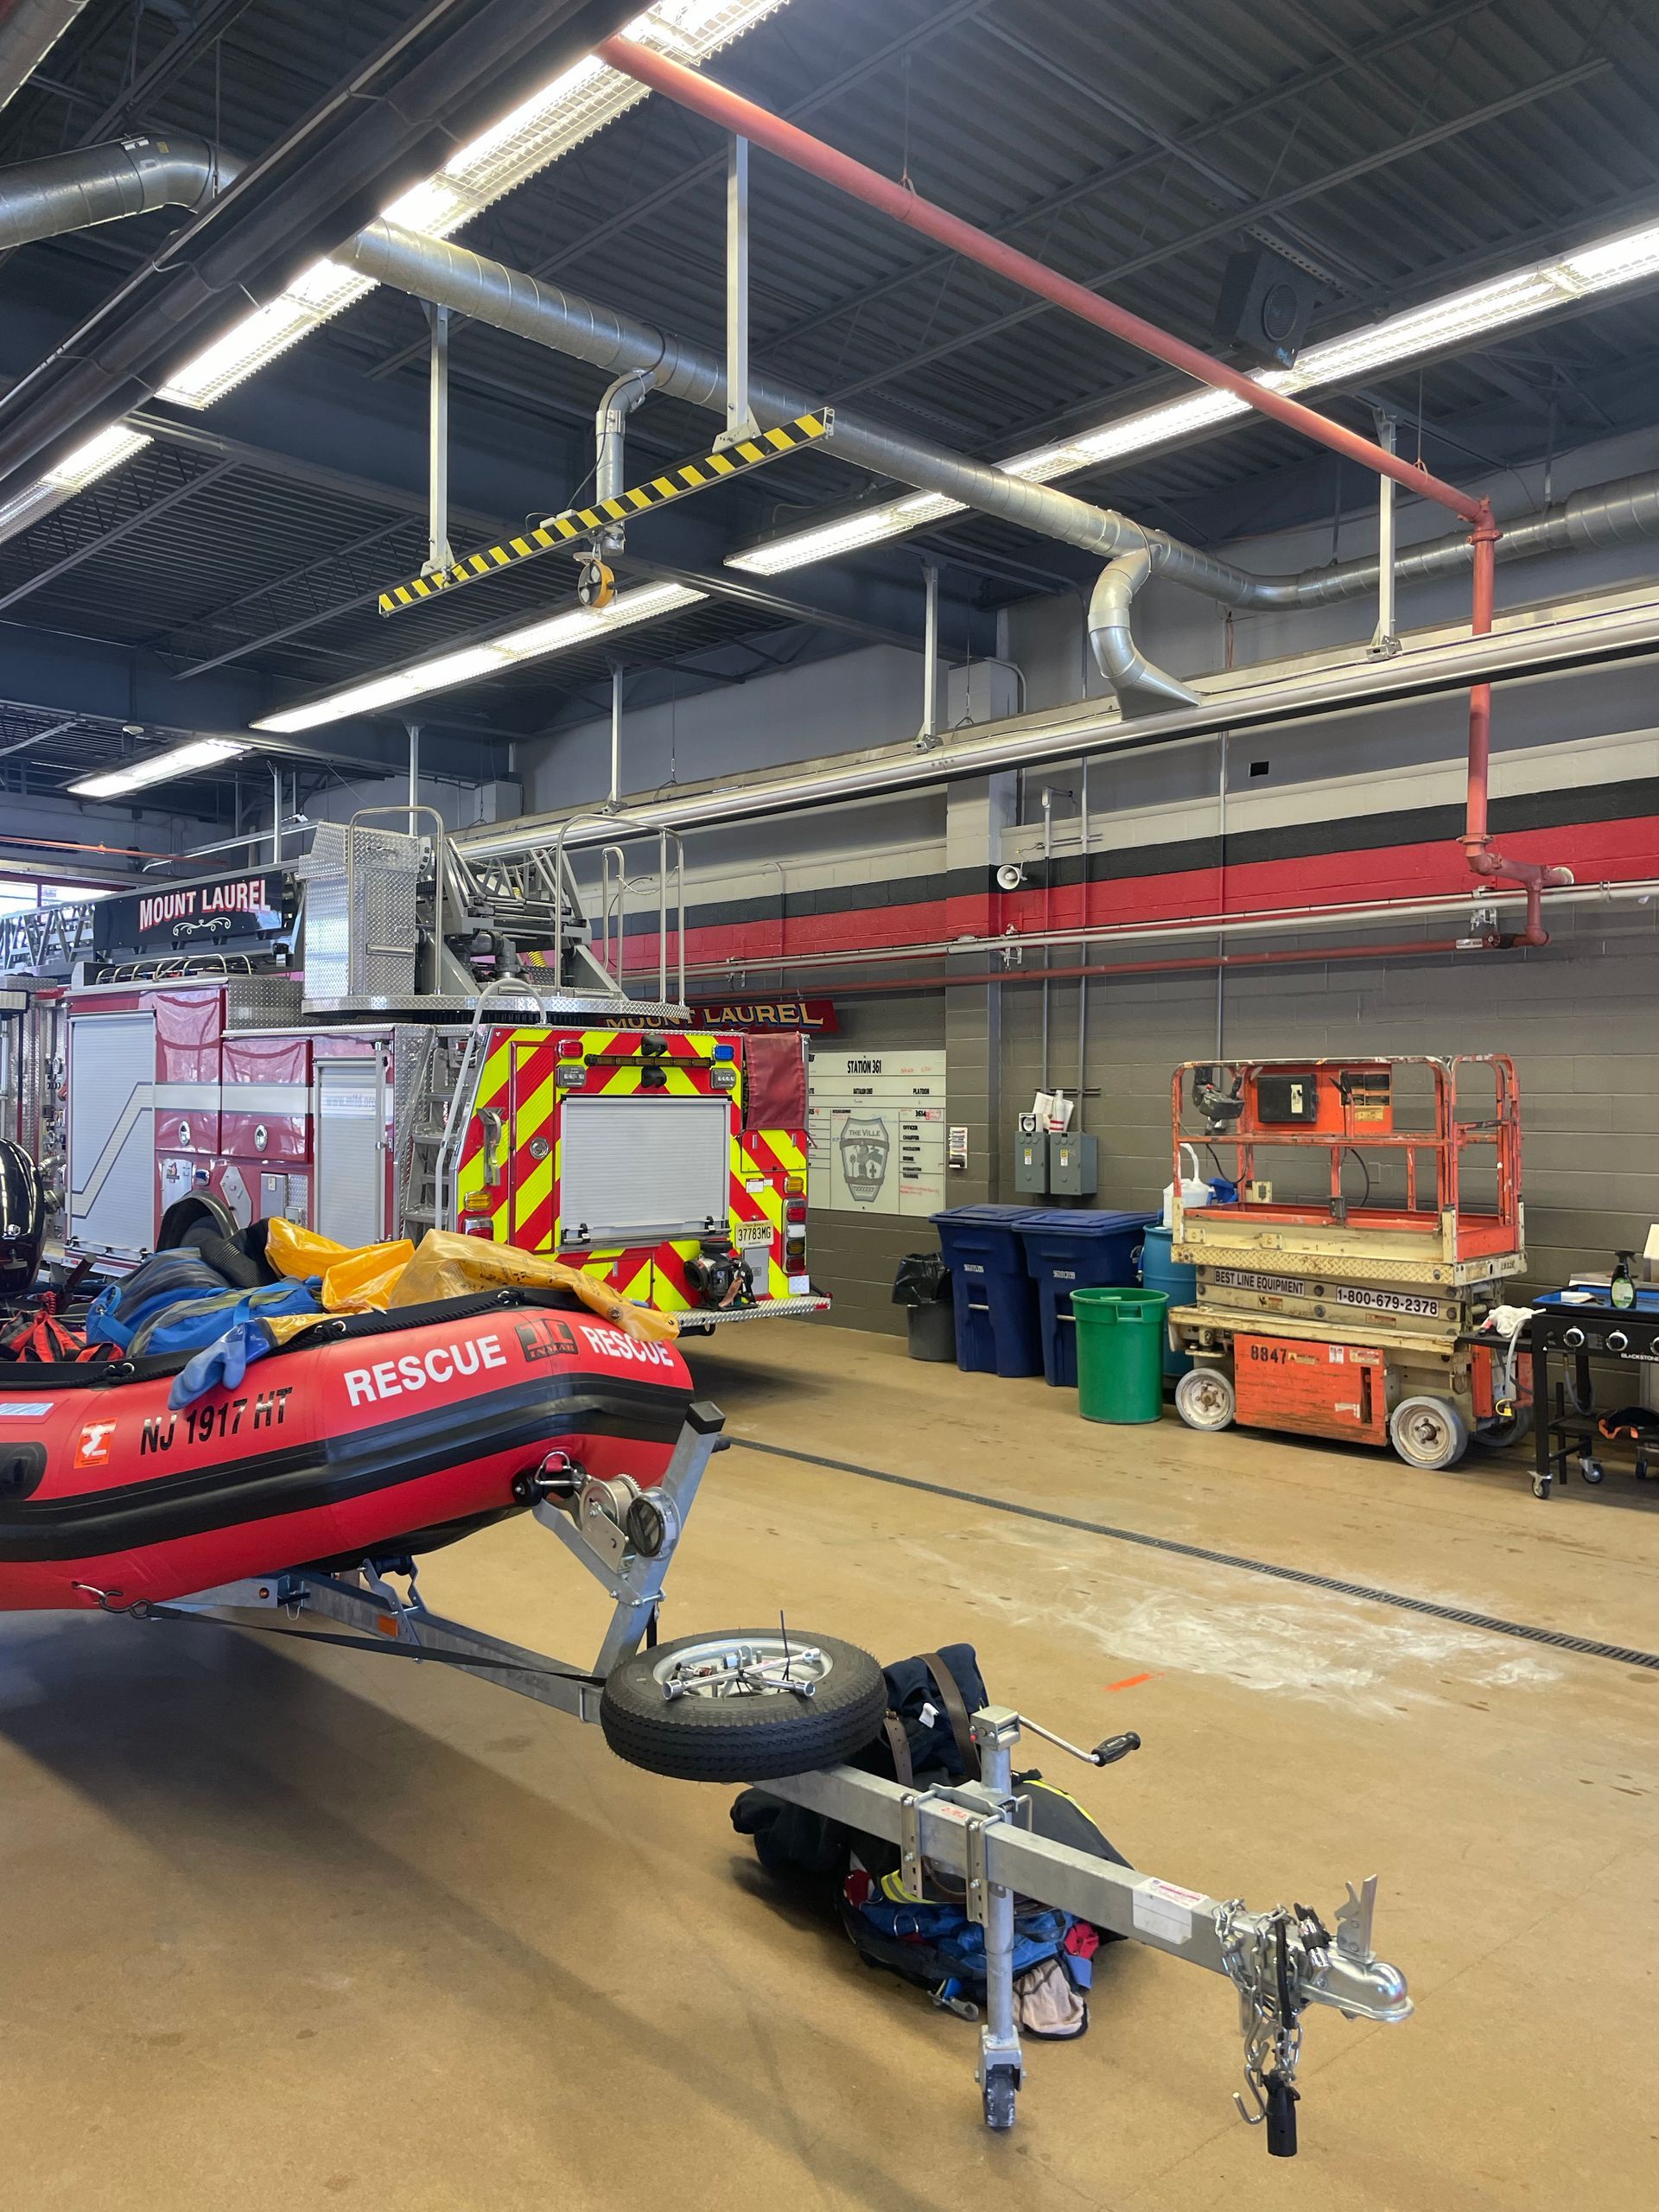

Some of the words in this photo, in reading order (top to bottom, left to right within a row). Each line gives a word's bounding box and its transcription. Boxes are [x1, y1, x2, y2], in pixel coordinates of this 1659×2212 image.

[139, 891, 196, 933] MOUNT
[201, 879, 271, 914] LAUREL
[703, 1002, 823, 1027] LAUREL
[848, 1060, 871, 1074] STATION
[872, 1060, 881, 1074] 361
[738, 1226, 771, 1242] 37783MG
[1215, 1269, 1235, 1284] BEST
[1236, 1273, 1254, 1287] LINE
[1256, 1275, 1304, 1294] EQUIPMENT
[1338, 1288, 1438, 1315] 1-800-679-2378
[343, 1334, 507, 1407] RESCUE
[578, 1325, 675, 1367] RESCUE
[140, 1413, 177, 1455] NJ
[186, 1398, 248, 1445] 1917
[254, 1386, 293, 1430] HT
